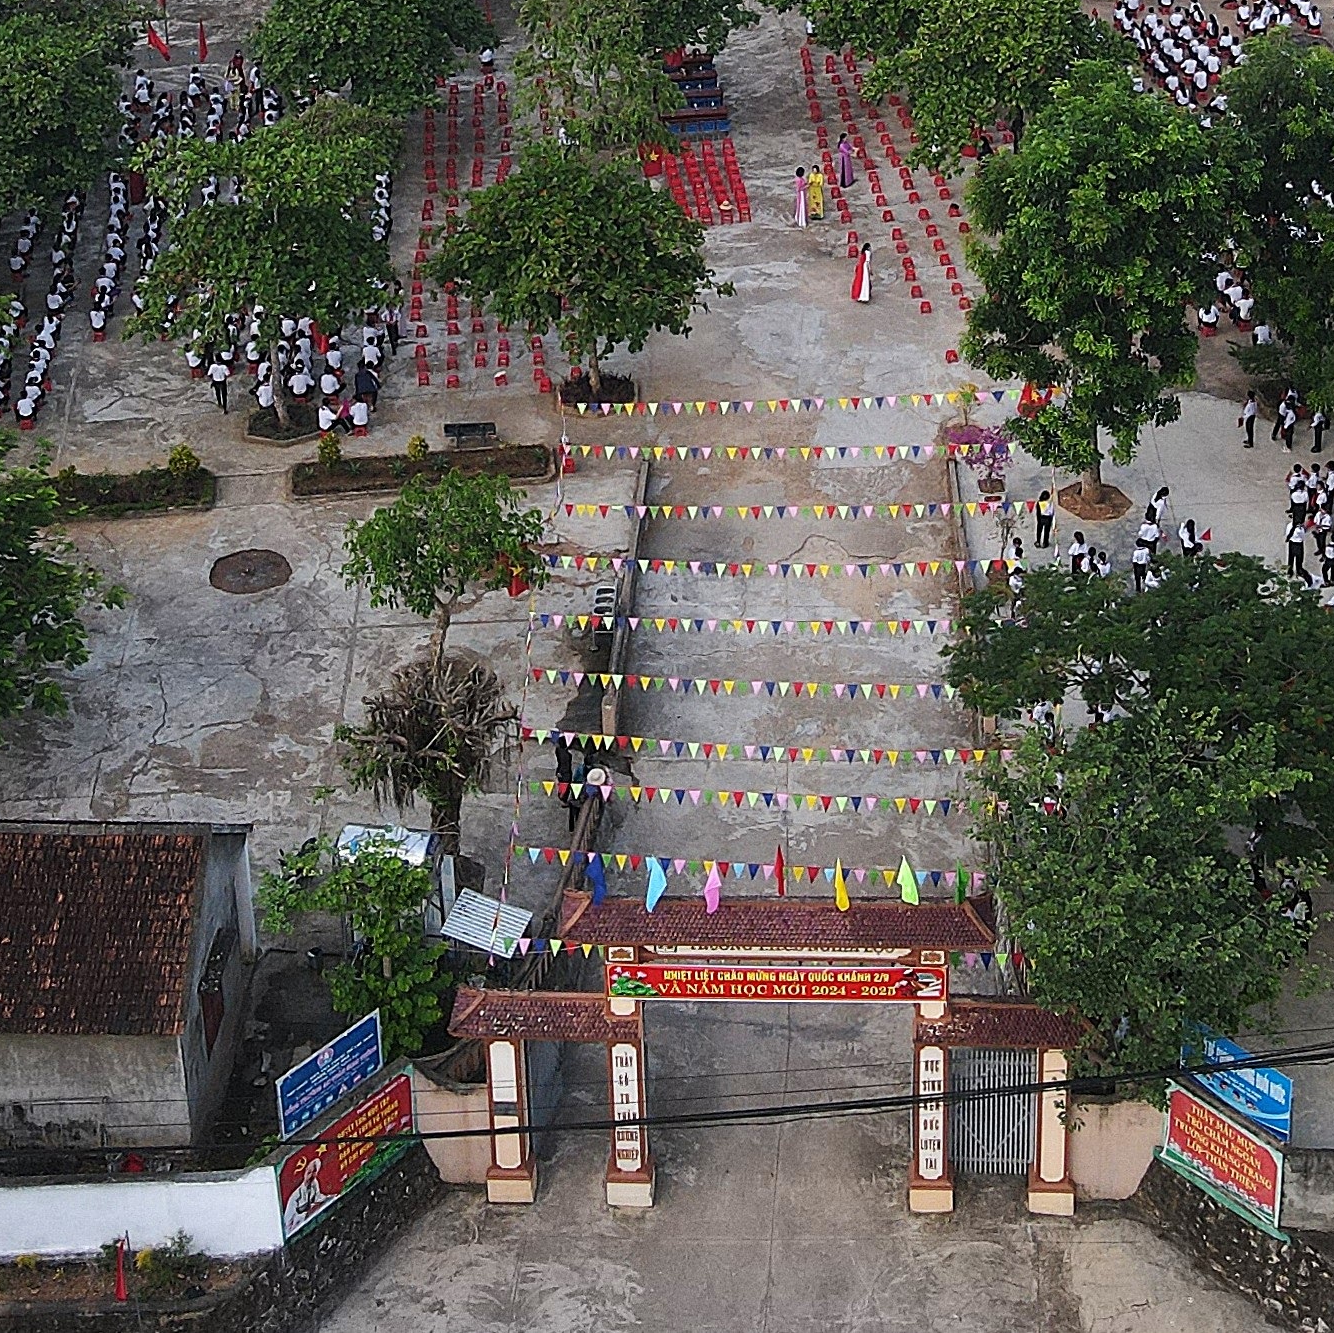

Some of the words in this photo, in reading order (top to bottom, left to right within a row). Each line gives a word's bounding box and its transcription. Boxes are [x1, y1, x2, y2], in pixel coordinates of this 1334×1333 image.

[663, 970, 692, 982] NHIỆT
[695, 969, 715, 983] LIỆT
[717, 969, 744, 982] CHÀO
[746, 969, 776, 982] MỪNG
[779, 970, 806, 983] NGÀY
[808, 969, 835, 983] QUỐC
[837, 970, 871, 983] KHÁNH
[658, 981, 681, 995] VÀ
[685, 981, 724, 995] NĂM
[731, 984, 768, 998] HỌC
[772, 982, 807, 996] MỚI
[811, 985, 847, 996] 2024
[1192, 1103, 1214, 1126] THẦY
[1237, 1135, 1257, 1154] MỰC
[1241, 1163, 1272, 1190] TRANG
